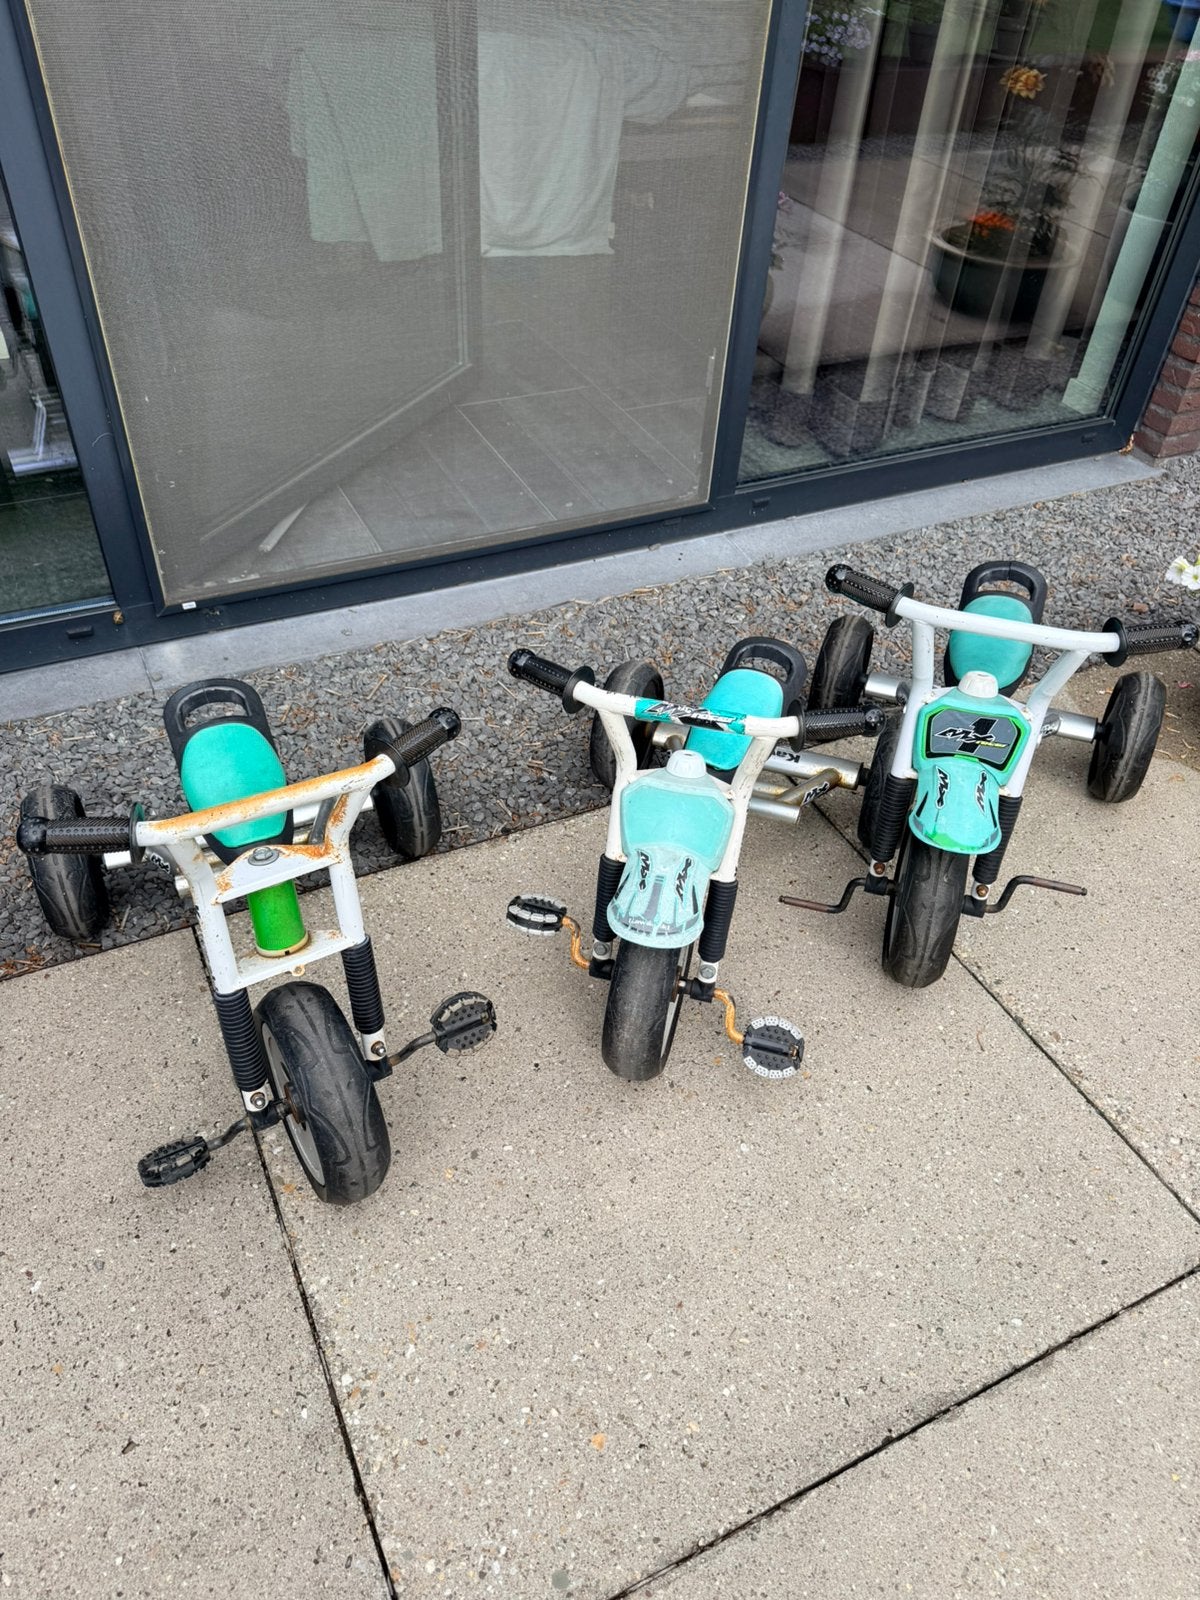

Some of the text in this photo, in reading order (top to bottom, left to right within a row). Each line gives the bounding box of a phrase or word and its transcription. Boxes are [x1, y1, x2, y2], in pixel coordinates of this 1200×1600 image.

[934, 727, 996, 743] MX
[801, 781, 829, 806] MX
[936, 766, 950, 809] MX
[975, 770, 988, 815] MX
[150, 852, 170, 874] MX
